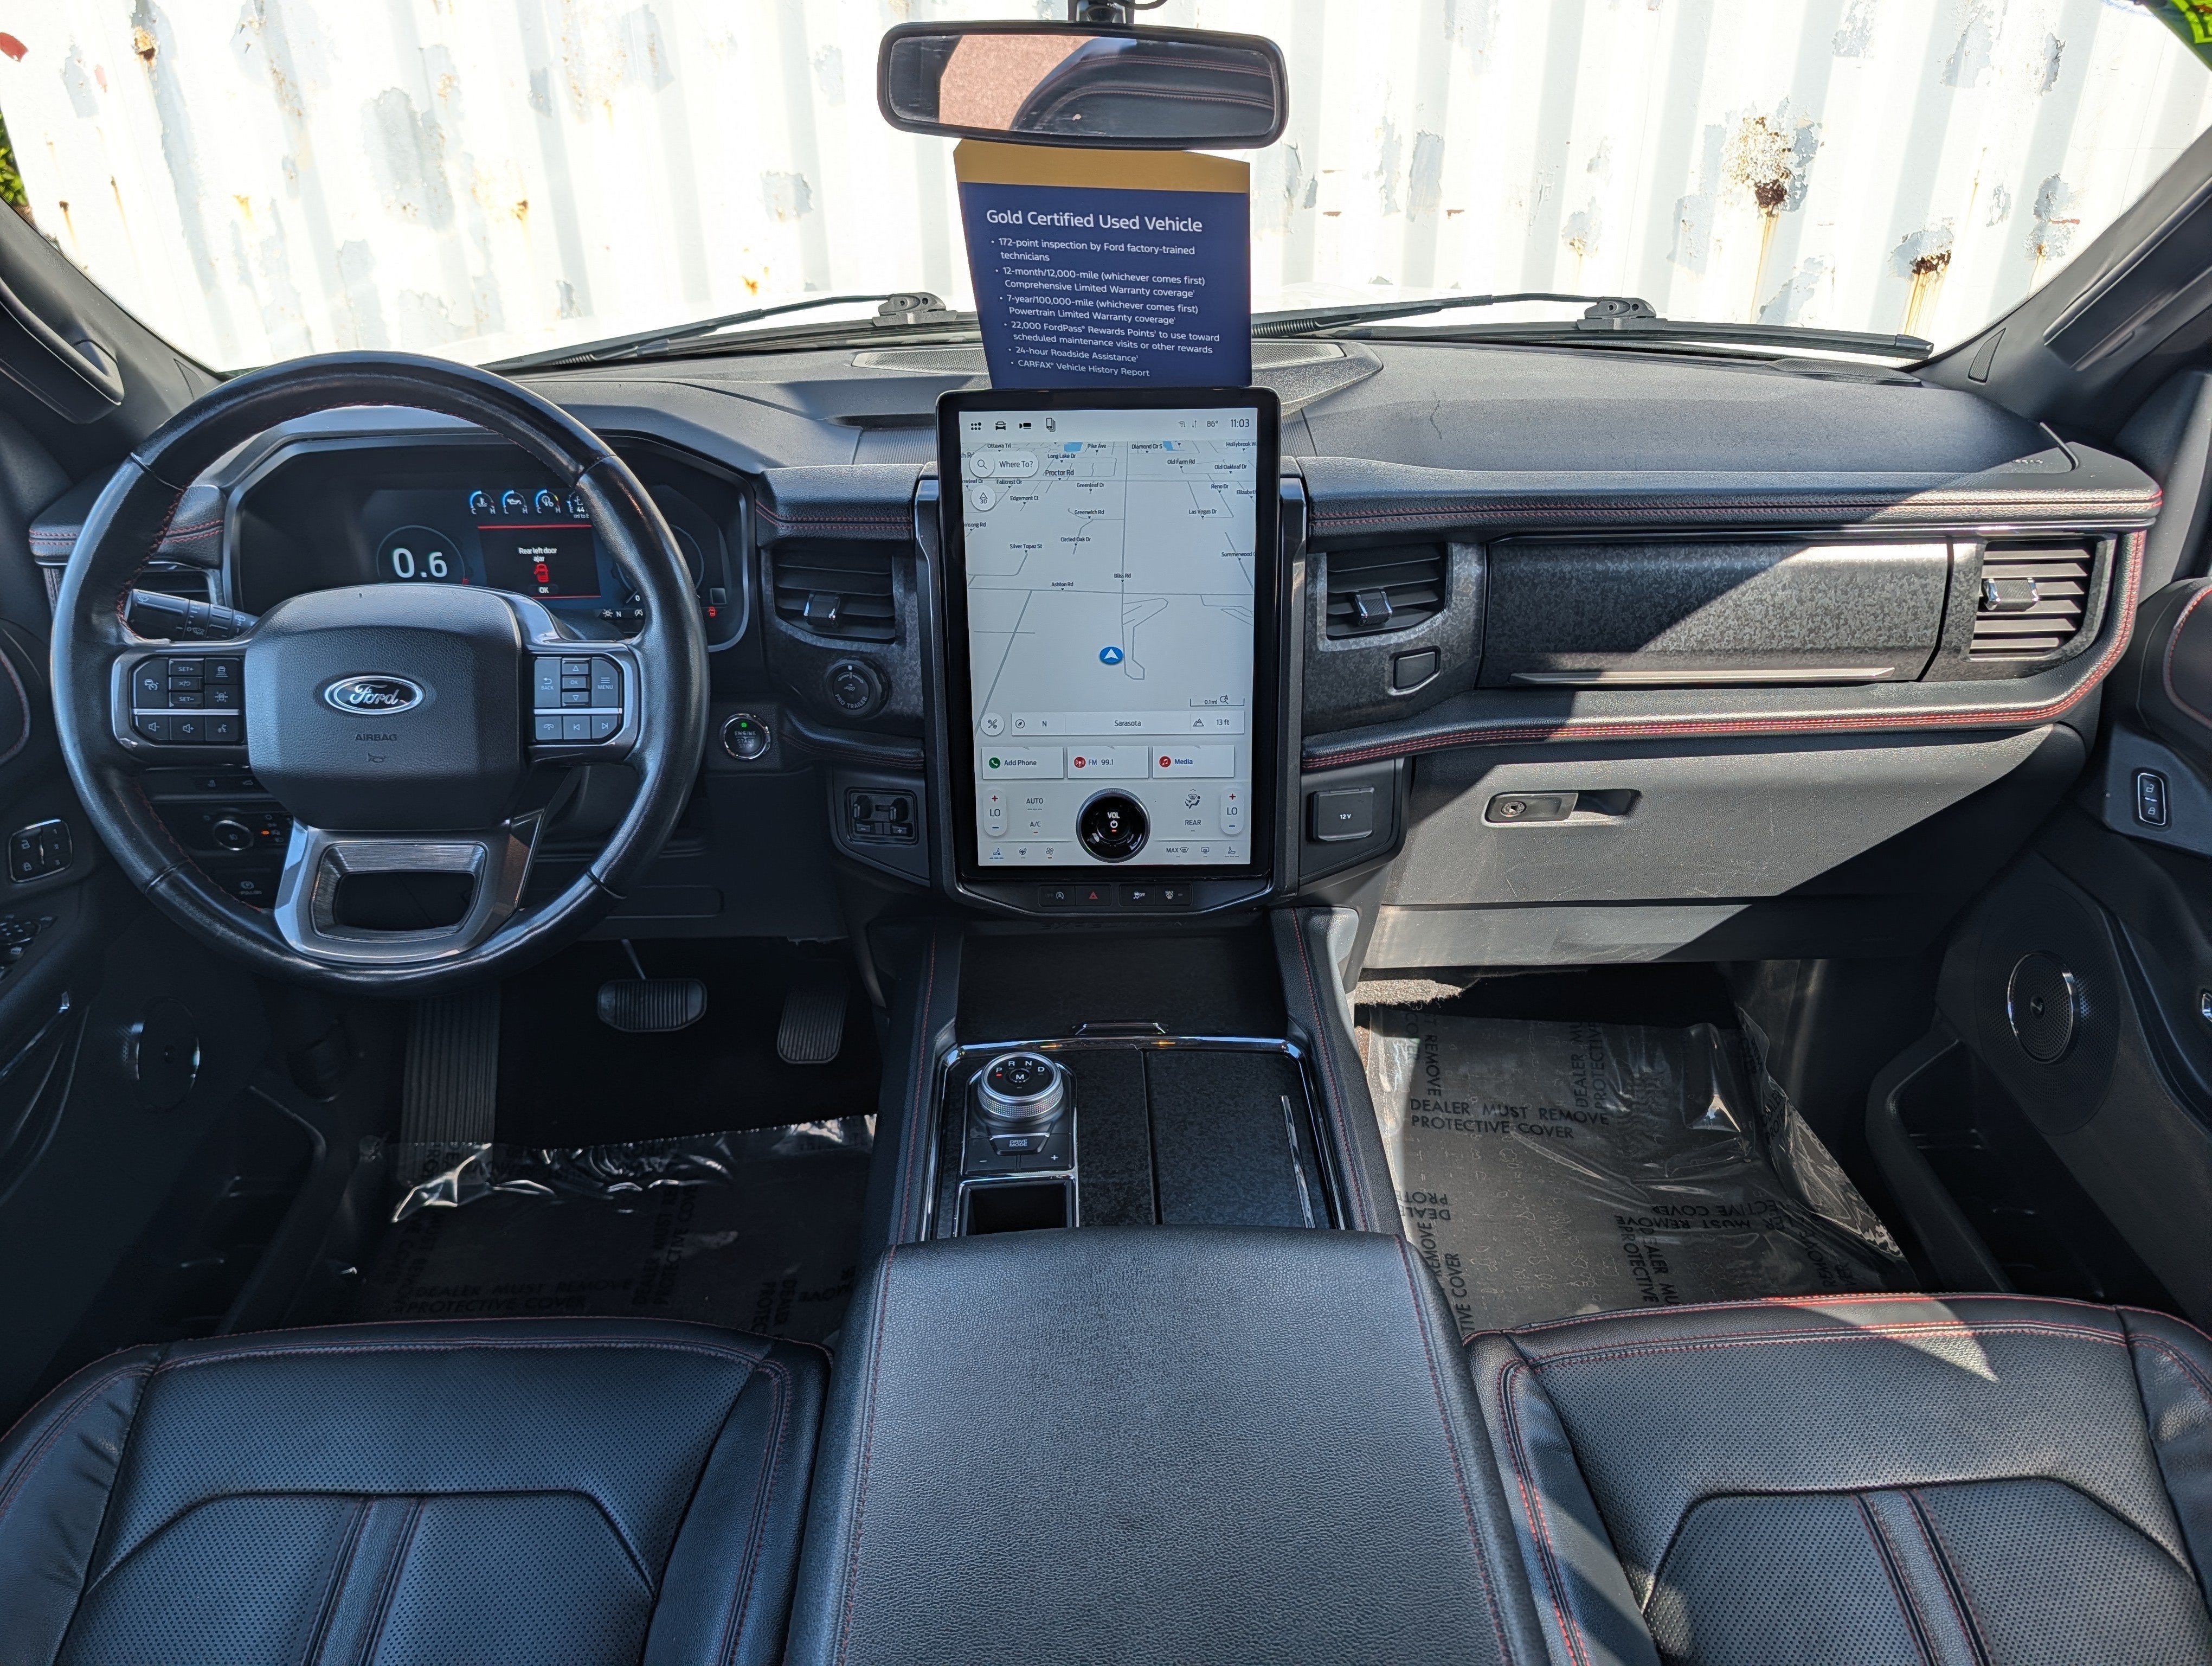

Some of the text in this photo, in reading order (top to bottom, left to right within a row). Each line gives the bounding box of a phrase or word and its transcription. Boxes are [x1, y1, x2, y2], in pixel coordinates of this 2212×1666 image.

[987, 210, 1203, 232] Gold Certified Used Vehicle
[998, 238, 1195, 254] 172-point inspection by Ford factory-trained
[1000, 251, 1050, 261] technicians
[1002, 267, 1099, 279] 12-month/12,000-mile
[1101, 272, 1149, 281] (whichever
[1184, 276, 1205, 286] first)
[1005, 280, 1072, 291] Comprehensive
[1075, 283, 1107, 292] Limited
[1109, 285, 1150, 296] Warranty
[1007, 294, 1094, 306] 7-year/100,000-mile
[1096, 299, 1144, 310] (whichever
[1177, 304, 1198, 315] first)
[1009, 307, 1056, 317] Powertrain
[1058, 310, 1090, 319] Limited
[1092, 312, 1132, 323] Warranty
[1011, 321, 1041, 330] 22,000
[1088, 326, 1125, 335] Rewards
[1188, 333, 1219, 342] toward
[1013, 333, 1057, 342] scheduled
[1059, 336, 1114, 347] maintenance
[1116, 340, 1138, 348] visits
[1152, 343, 1175, 351] other
[1178, 345, 1213, 354] rewards
[1015, 347, 1049, 355] 24-hour
[1051, 349, 1089, 358] Roadside
[1056, 363, 1086, 371] Vehicle
[1088, 365, 1118, 375] History
[1121, 368, 1150, 376] Report
[1230, 419, 1250, 428] 11:03
[393, 548, 448, 578] 0.6
[350, 683, 400, 705] Ford
[835, 694, 867, 709] PRO TRAILER
[989, 809, 1001, 817] LO
[1226, 806, 1238, 816] LO
[1425, 1035, 1442, 1097] REMOVE
[1571, 1054, 1589, 1107] DEALER
[1410, 1098, 1610, 1125] DEALER MUST REMOVE
[1411, 1115, 1574, 1139] PROTECTIVE COVER
[1702, 1220, 1751, 1229] MUST
[1618, 1225, 1660, 1303] PROTECTIVE
[1444, 1253, 1468, 1298] COVER
